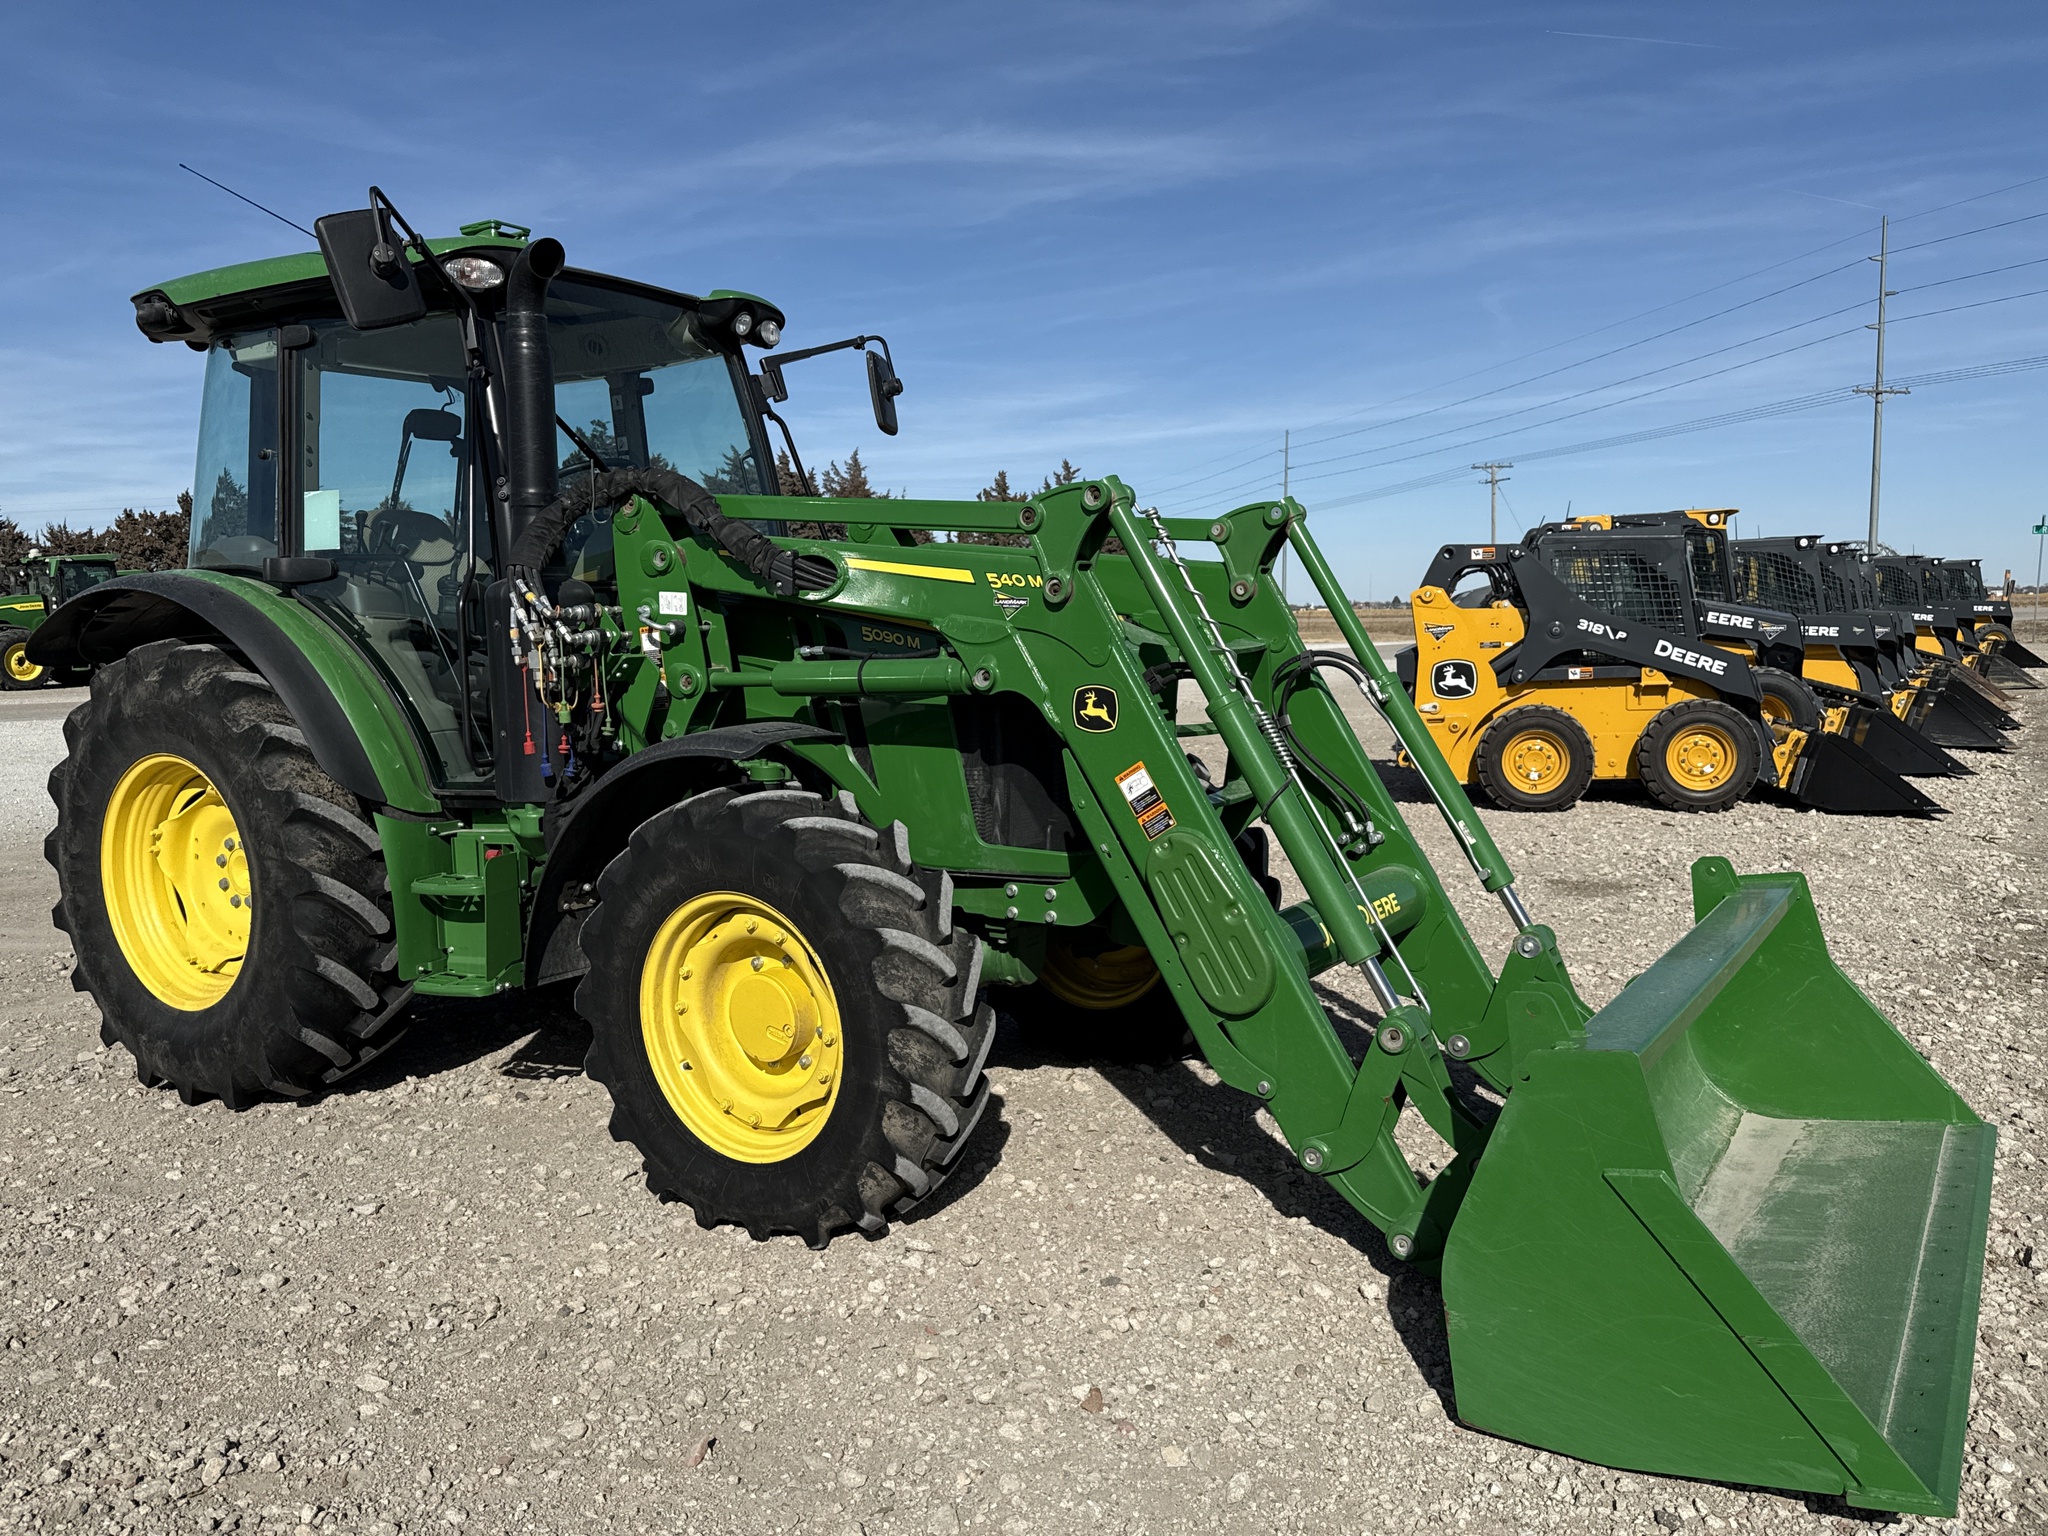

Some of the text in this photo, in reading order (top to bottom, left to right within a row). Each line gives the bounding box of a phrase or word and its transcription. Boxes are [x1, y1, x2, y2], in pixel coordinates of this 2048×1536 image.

[985, 572, 1044, 589] 540 M
[1706, 611, 1755, 629] EERE
[861, 625, 920, 650] 5090 M
[1653, 639, 1728, 676] DEERE
